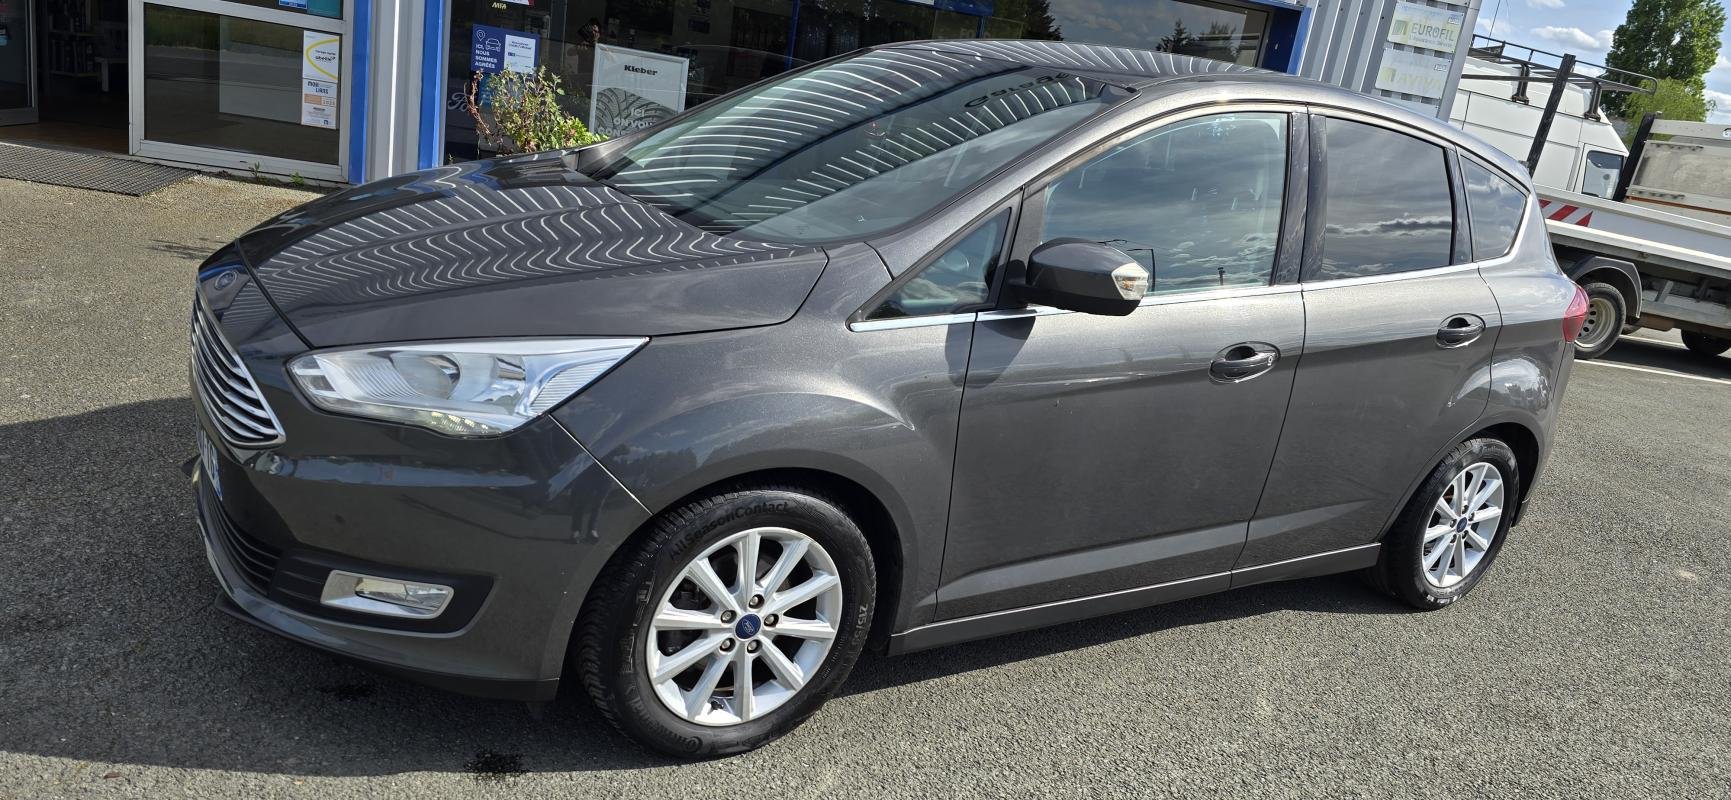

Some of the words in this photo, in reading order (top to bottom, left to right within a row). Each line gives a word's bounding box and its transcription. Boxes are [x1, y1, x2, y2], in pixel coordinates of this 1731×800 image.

[1411, 23, 1455, 42] EUROFIL
[475, 55, 498, 63] SOMMES
[624, 64, 658, 76] Kleber
[613, 117, 628, 127] ON
